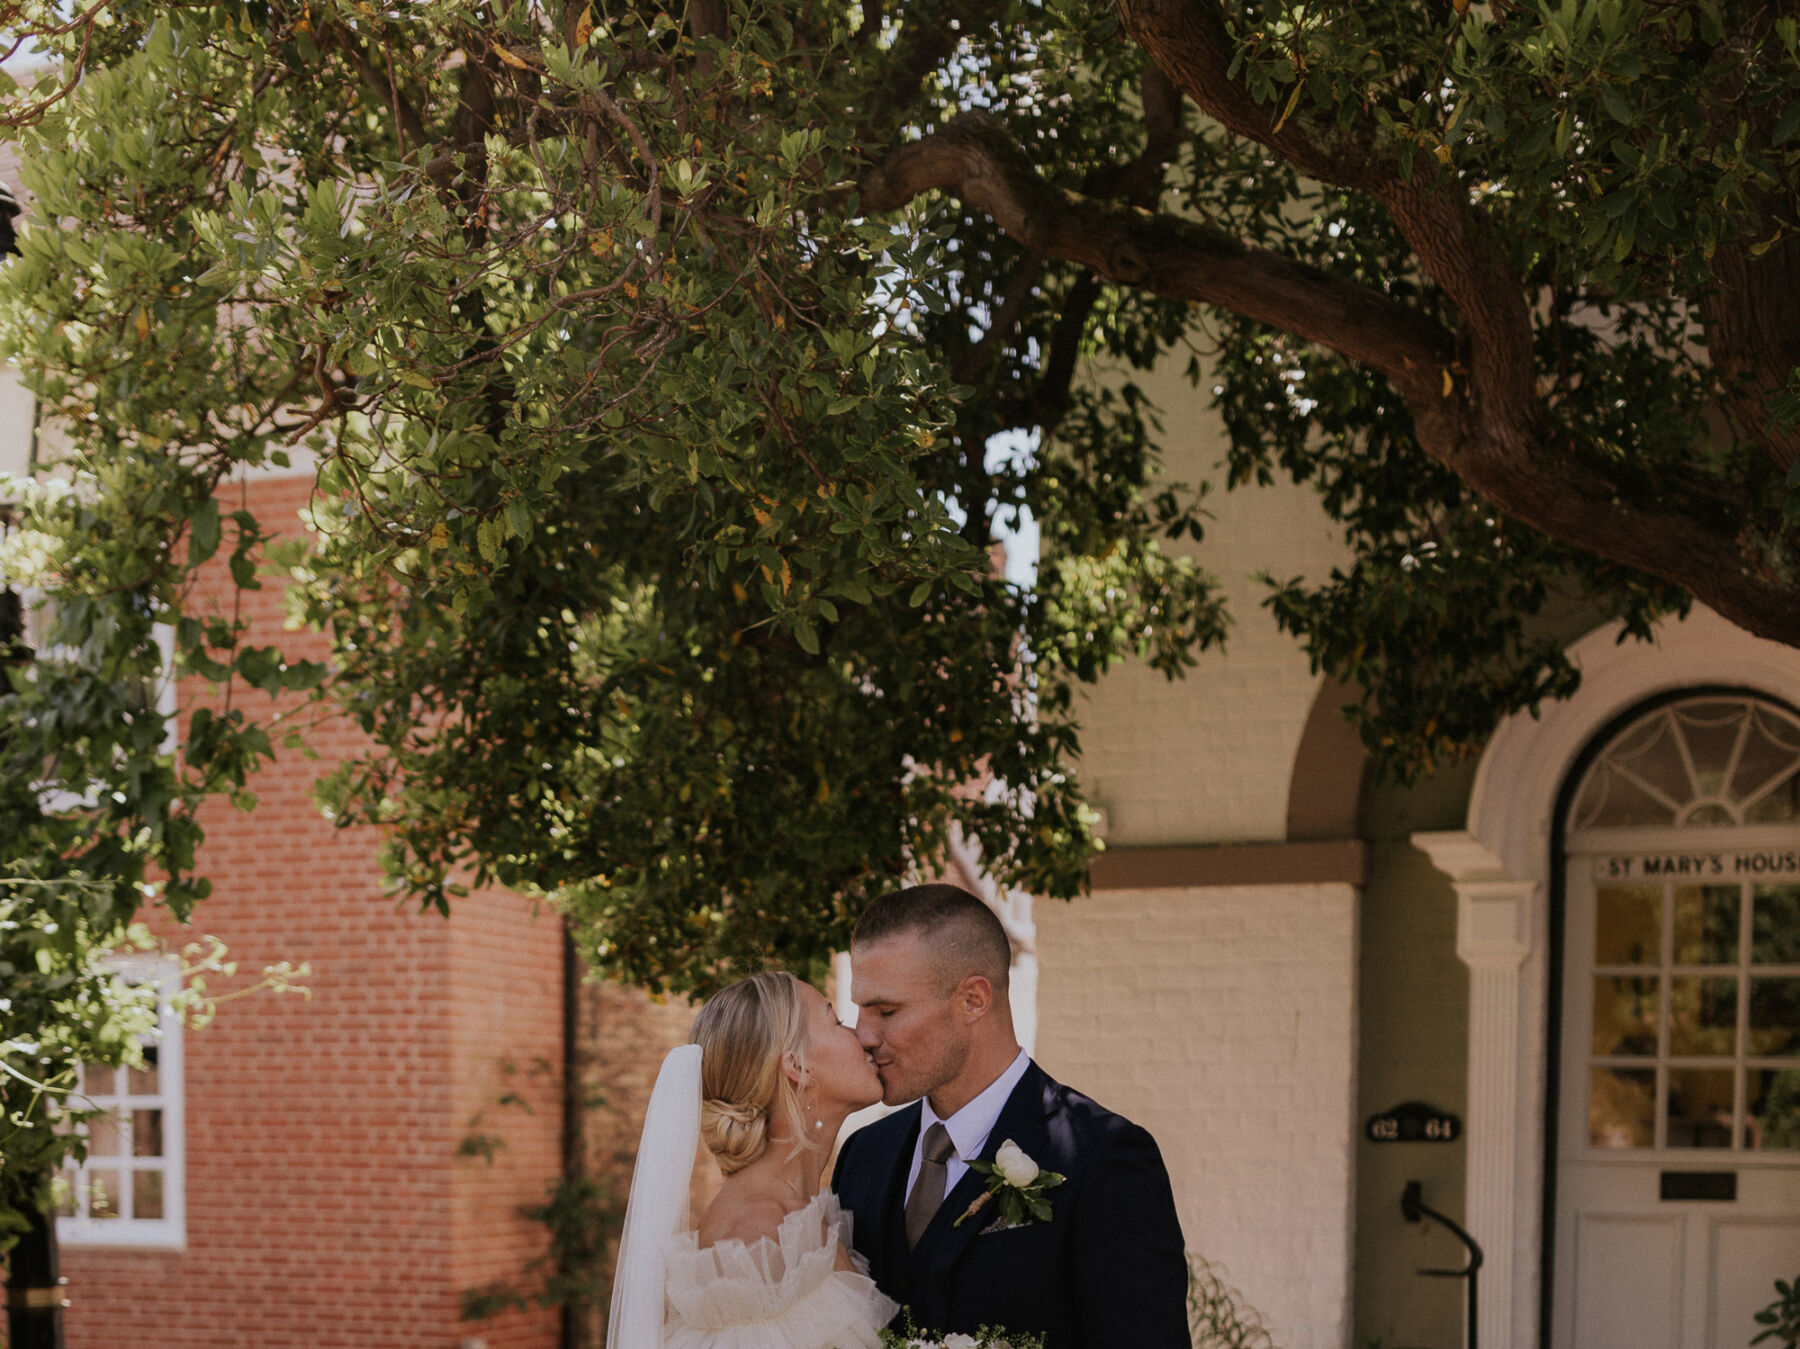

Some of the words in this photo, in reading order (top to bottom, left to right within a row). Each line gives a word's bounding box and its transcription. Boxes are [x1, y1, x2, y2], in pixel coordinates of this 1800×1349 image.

[1609, 857, 1631, 876] ST
[1644, 854, 1723, 875] MARY'S
[1735, 852, 1800, 873] HOUS
[1372, 1118, 1398, 1138] 62
[1425, 1118, 1451, 1139] 64
